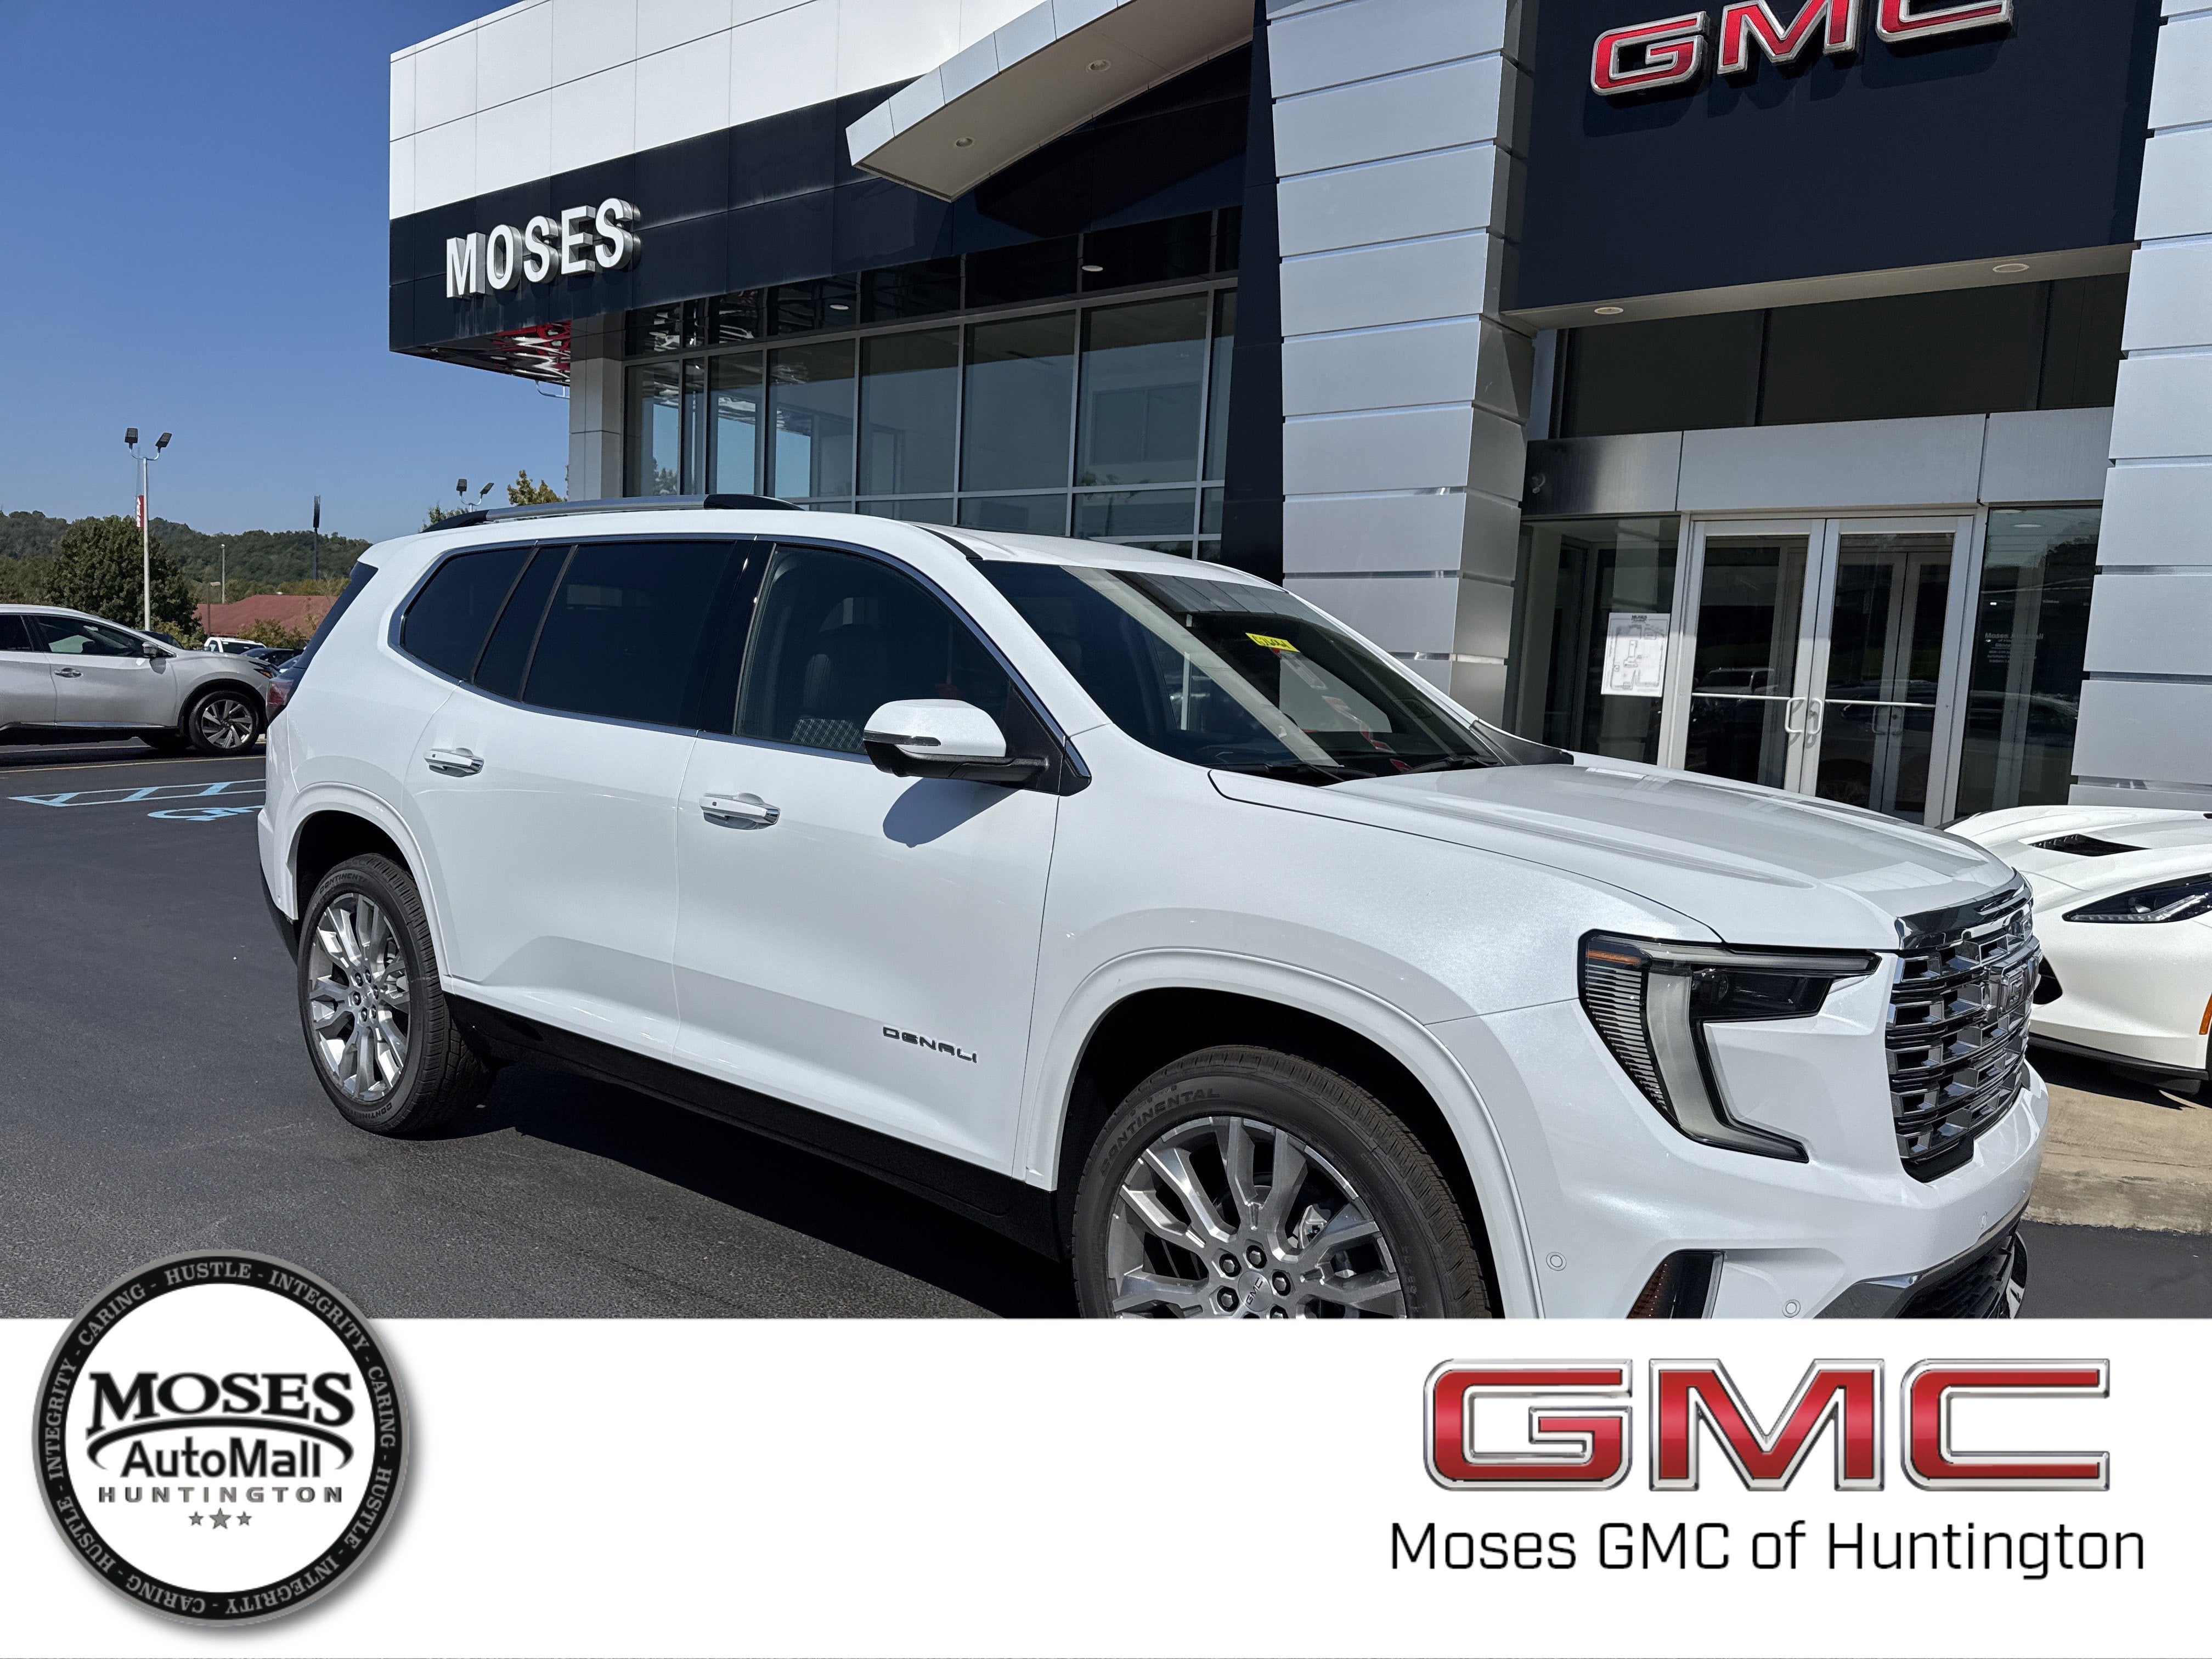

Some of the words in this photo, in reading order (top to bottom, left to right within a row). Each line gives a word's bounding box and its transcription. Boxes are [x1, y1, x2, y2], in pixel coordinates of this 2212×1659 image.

[1591, 0, 2012, 95] GMC
[446, 198, 640, 298] MOSES
[882, 1024, 978, 1063] DENALI
[1099, 1088, 1220, 1175] CONTINENTAL
[1245, 1277, 1263, 1306] GMC
